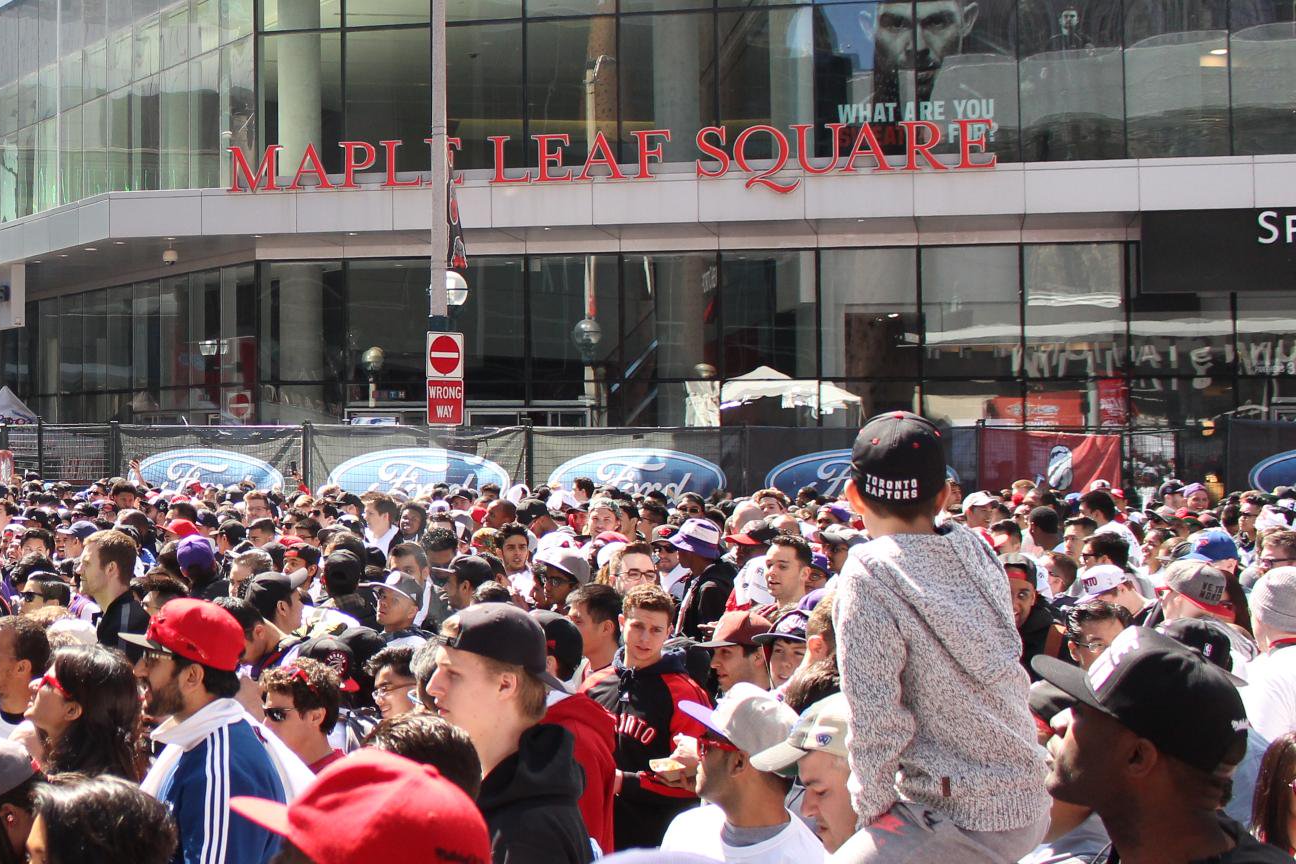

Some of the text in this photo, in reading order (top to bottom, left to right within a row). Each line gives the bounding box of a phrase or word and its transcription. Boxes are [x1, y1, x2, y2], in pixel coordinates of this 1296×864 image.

[838, 98, 994, 125] WHAT ARE YOU
[227, 119, 997, 193] MAPLE LEAF SQUARE
[429, 385, 462, 399] WRONG
[436, 405, 454, 418] WAY
[866, 473, 918, 490] TORONTO
[865, 482, 918, 500] RAPTORS
